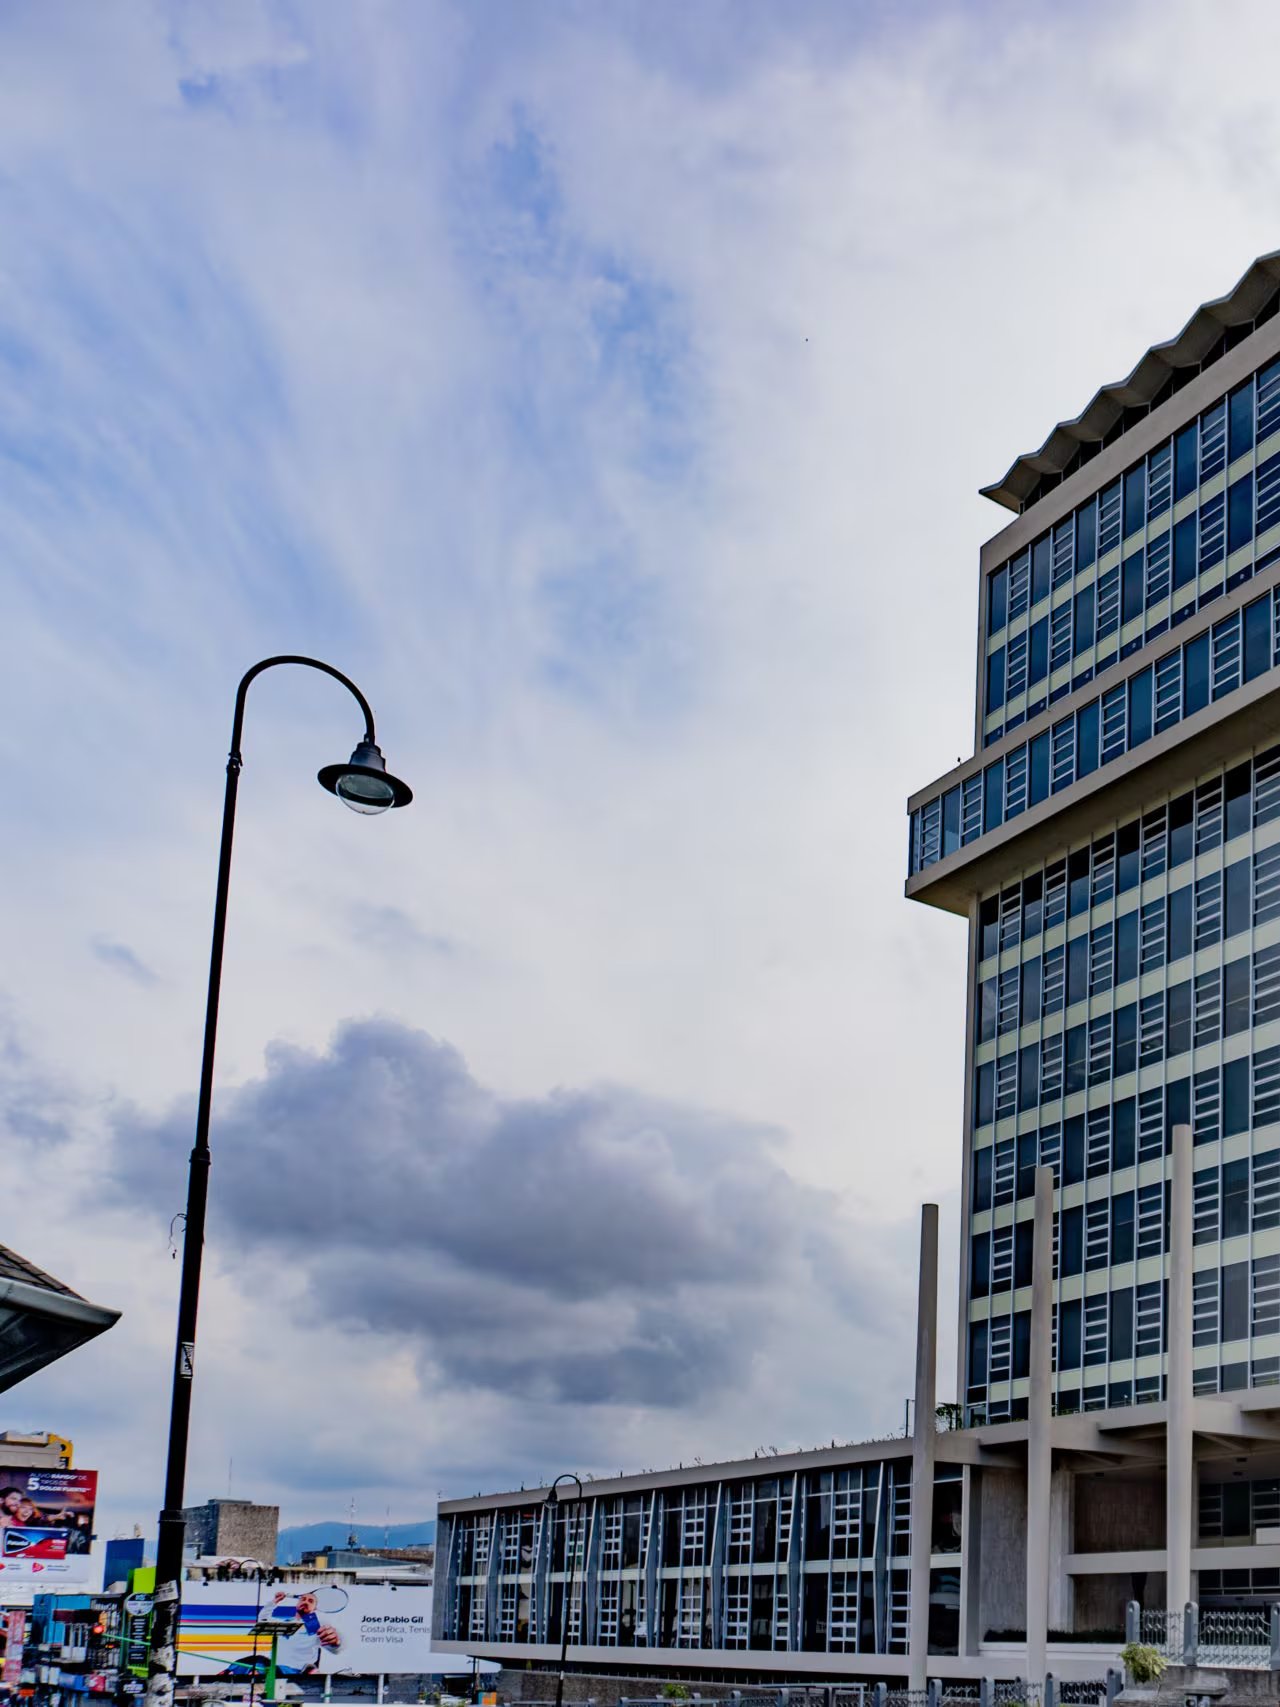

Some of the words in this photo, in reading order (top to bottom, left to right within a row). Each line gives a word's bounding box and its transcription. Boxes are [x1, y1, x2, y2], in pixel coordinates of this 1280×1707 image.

[26, 1477, 40, 1491] 5
[361, 1615, 382, 1623] Jose
[384, 1616, 410, 1624] Pablo
[411, 1616, 424, 1624] Gil
[360, 1624, 385, 1633] Costa
[387, 1625, 407, 1634] Rica,
[408, 1625, 431, 1634] Tenis
[360, 1634, 384, 1643] Team
[386, 1635, 404, 1643] Visa
